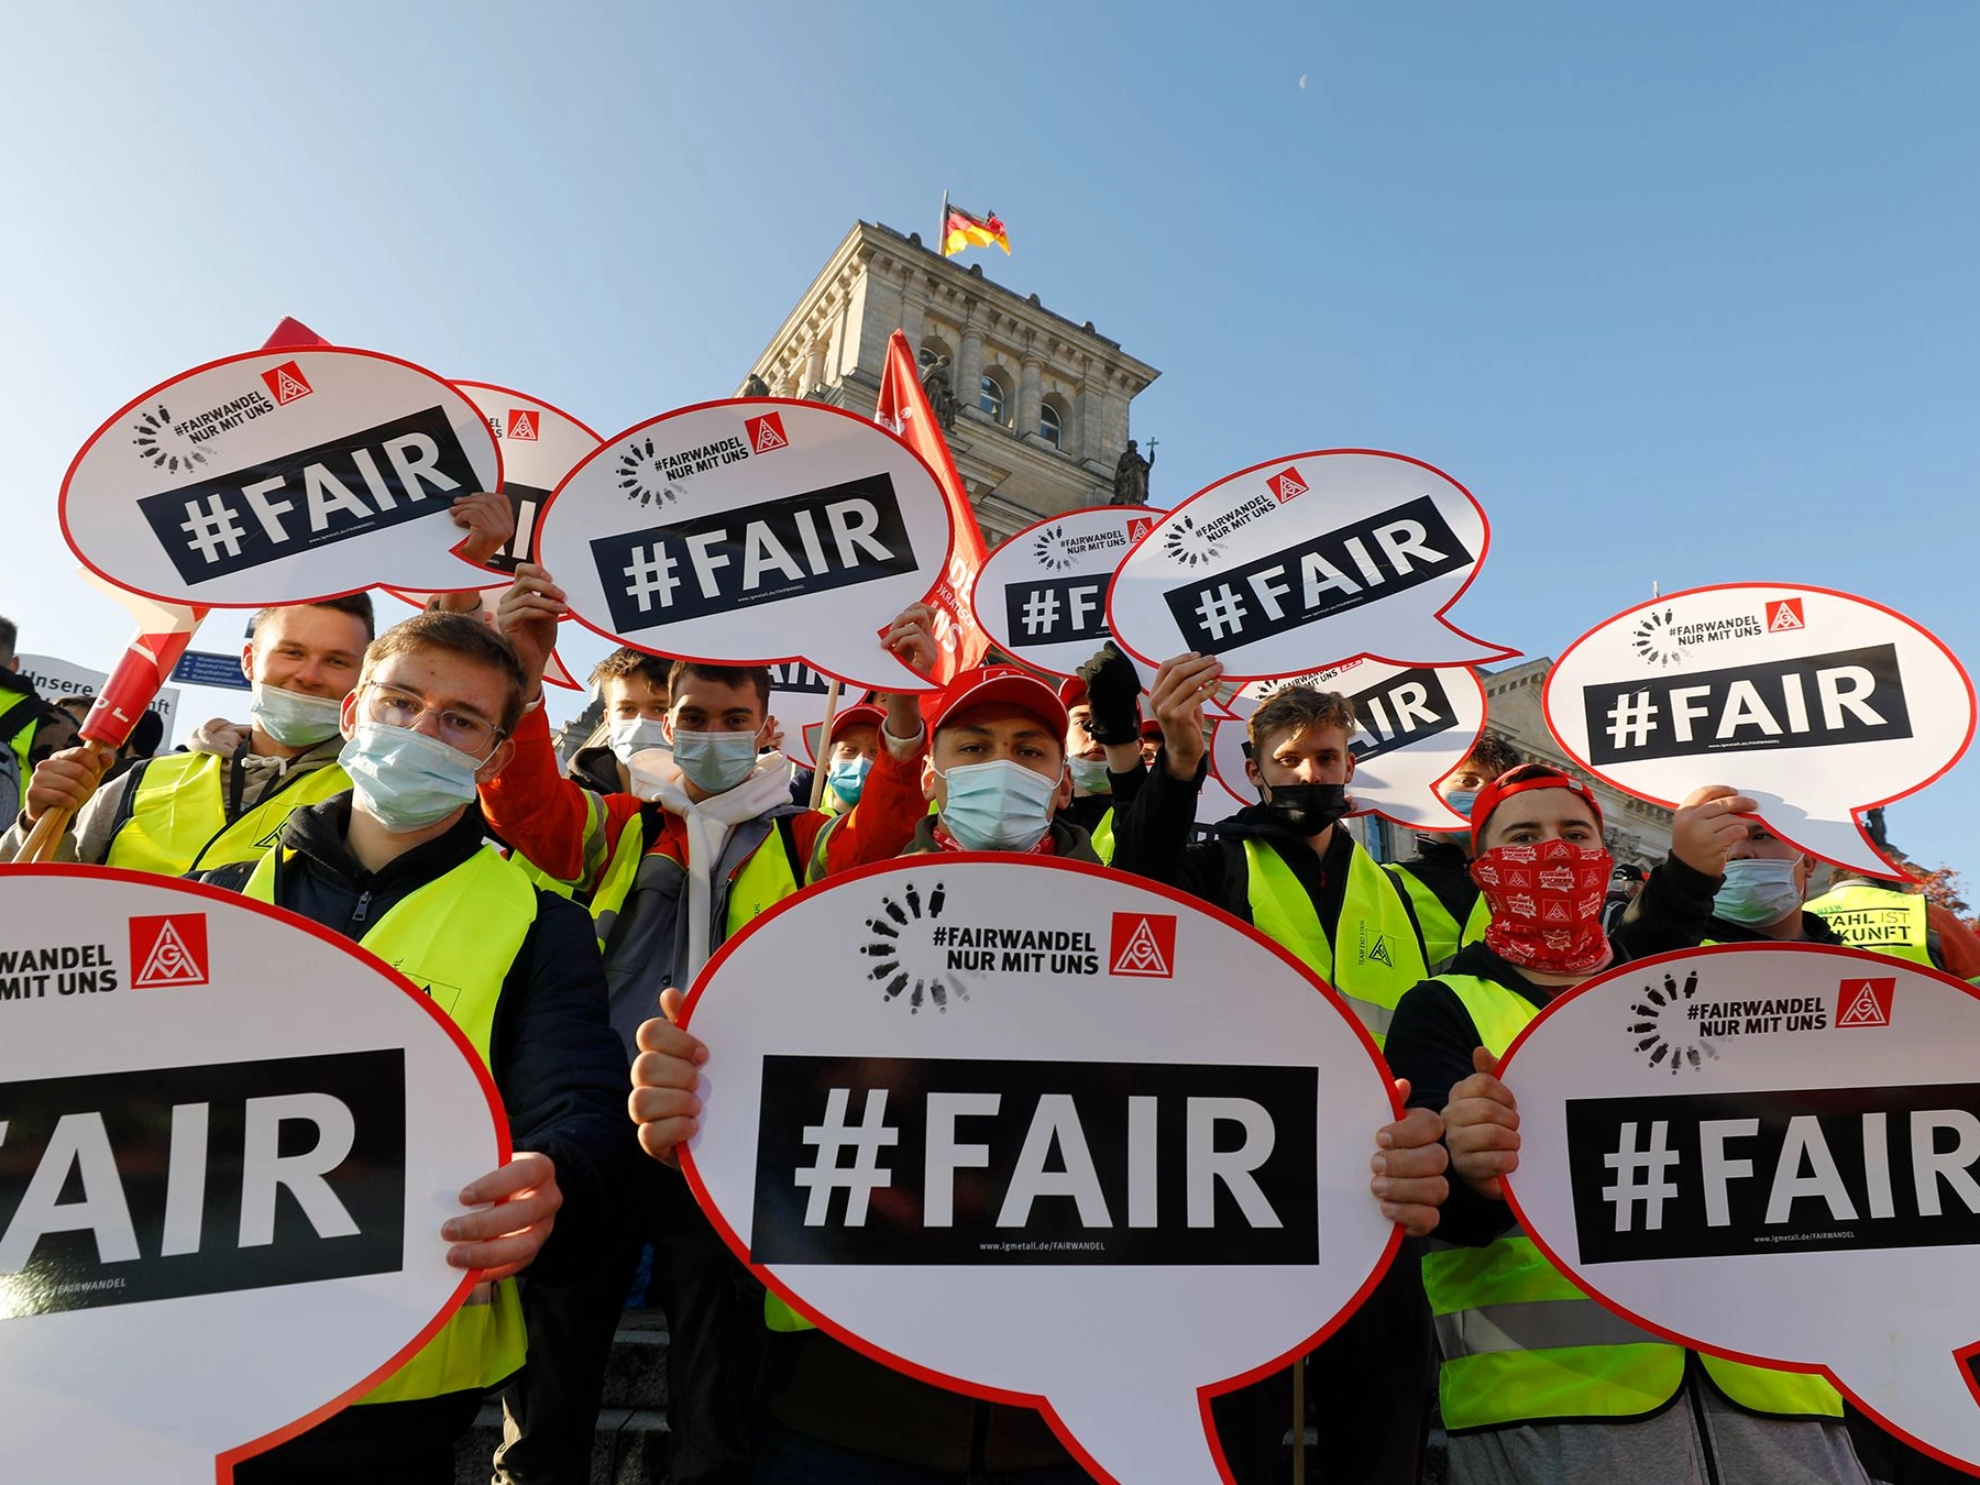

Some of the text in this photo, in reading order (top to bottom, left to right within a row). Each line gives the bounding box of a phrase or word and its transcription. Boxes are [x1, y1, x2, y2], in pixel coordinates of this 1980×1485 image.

[174, 391, 266, 436] #FAIRWANDEL
[188, 400, 275, 444] NUR MIT UNS
[654, 436, 744, 472] #FAIRWANDEL
[665, 447, 749, 481] NUR MIT UNS
[180, 432, 462, 564] #FAIR
[1195, 494, 1270, 538] #FAIRWANDEL
[1206, 500, 1277, 542] NUR MIT UNS
[1060, 530, 1124, 548] #FAIRWANDEL
[1066, 538, 1126, 555] NUR MIT UNS
[623, 498, 896, 613] #FAIR
[1195, 518, 1450, 641] #FAIR
[1669, 615, 1759, 637] #FAIRWANDEL
[1677, 625, 1762, 646] NUR MIT UNS
[1319, 669, 1339, 681] UNS
[1605, 665, 1888, 749] #FAIR
[1823, 912, 1911, 927] TAHL IST
[1836, 926, 1912, 942] KUNFT
[933, 926, 1096, 952] #FAIRWANDEL
[0, 944, 113, 974] WANDEL
[947, 950, 1099, 975] NUR MIT UNS
[0, 969, 118, 1001] MIT UNS
[1687, 997, 1826, 1020] #FAIRWANDEL
[1700, 1014, 1827, 1037] NUR MIT UNS
[794, 1088, 1284, 1230] #FAIR
[1602, 1109, 1980, 1232] #FAIR
[0, 1092, 362, 1276] AIR
[979, 1241, 1106, 1252] www.igmetall.de/FAIRWANDEL
